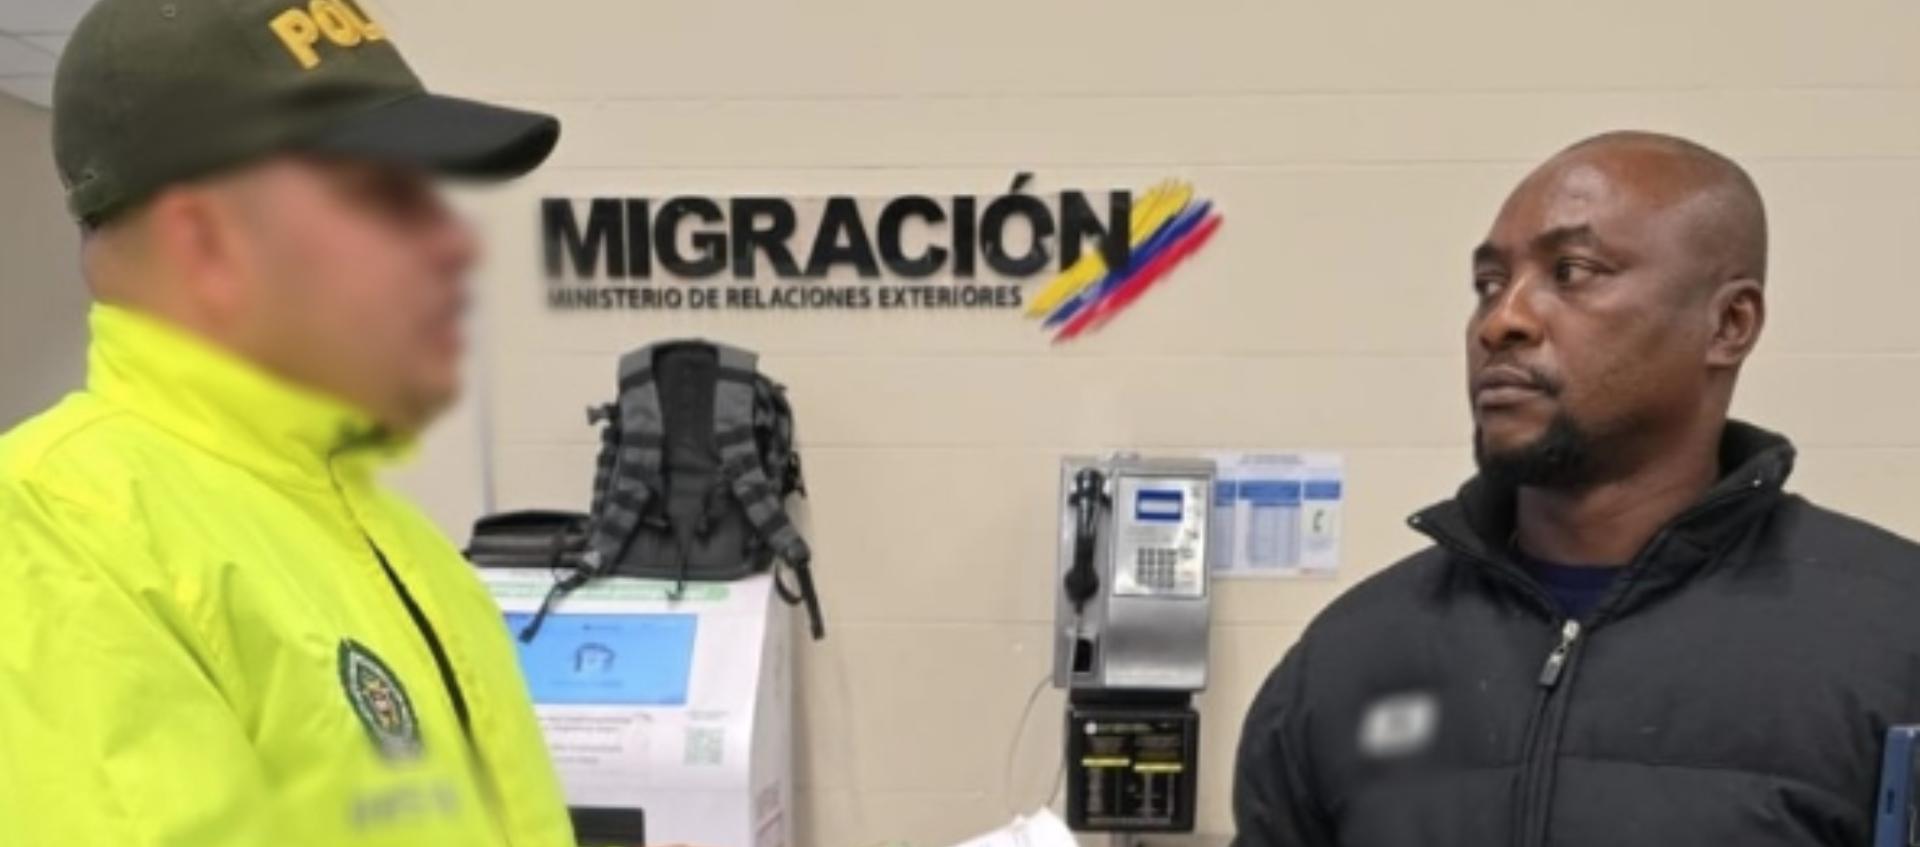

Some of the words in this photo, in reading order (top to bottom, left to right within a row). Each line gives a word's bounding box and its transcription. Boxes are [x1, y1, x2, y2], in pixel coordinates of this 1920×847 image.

[542, 172, 1132, 279] MIGRACIÓN
[688, 287, 719, 309] DE
[726, 286, 871, 309] RELACIONES
[878, 285, 1022, 308] EXTERIORES
